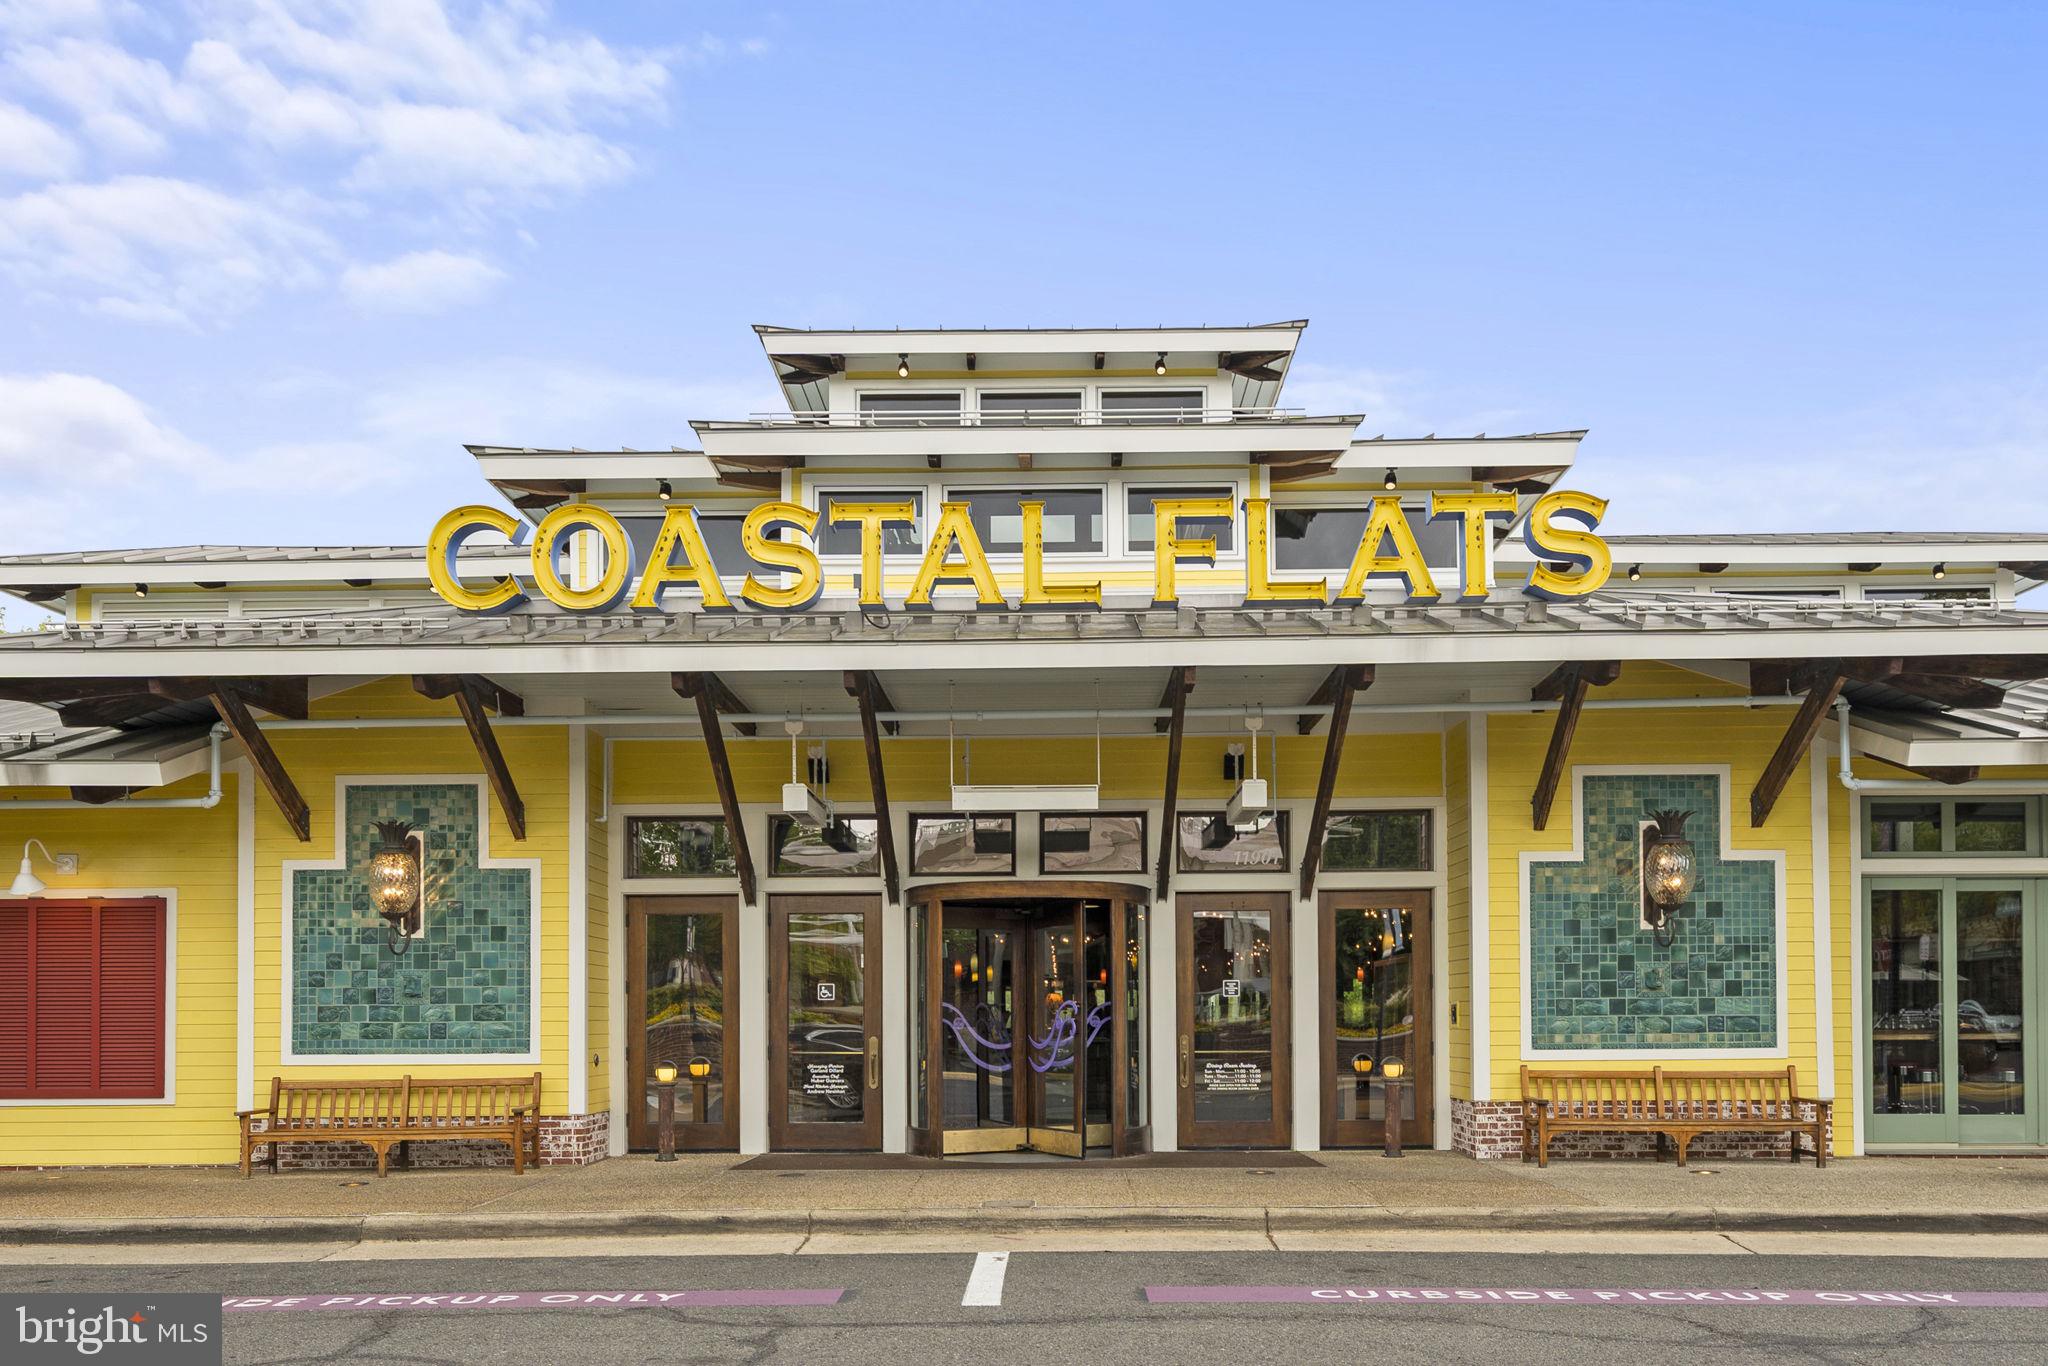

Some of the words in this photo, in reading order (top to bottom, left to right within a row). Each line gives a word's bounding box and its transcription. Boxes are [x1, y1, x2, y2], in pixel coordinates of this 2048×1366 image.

[426, 497, 1102, 614] COASTAL
[1151, 489, 1612, 609] FLATS
[1234, 848, 1280, 865] 11901
[319, 1295, 520, 1306] PICKUP
[539, 1293, 685, 1303] ONLY
[1311, 1289, 1575, 1300] CURBSIDE
[1593, 1290, 1790, 1301] PICKUP
[1815, 1292, 1960, 1303] ONLY
